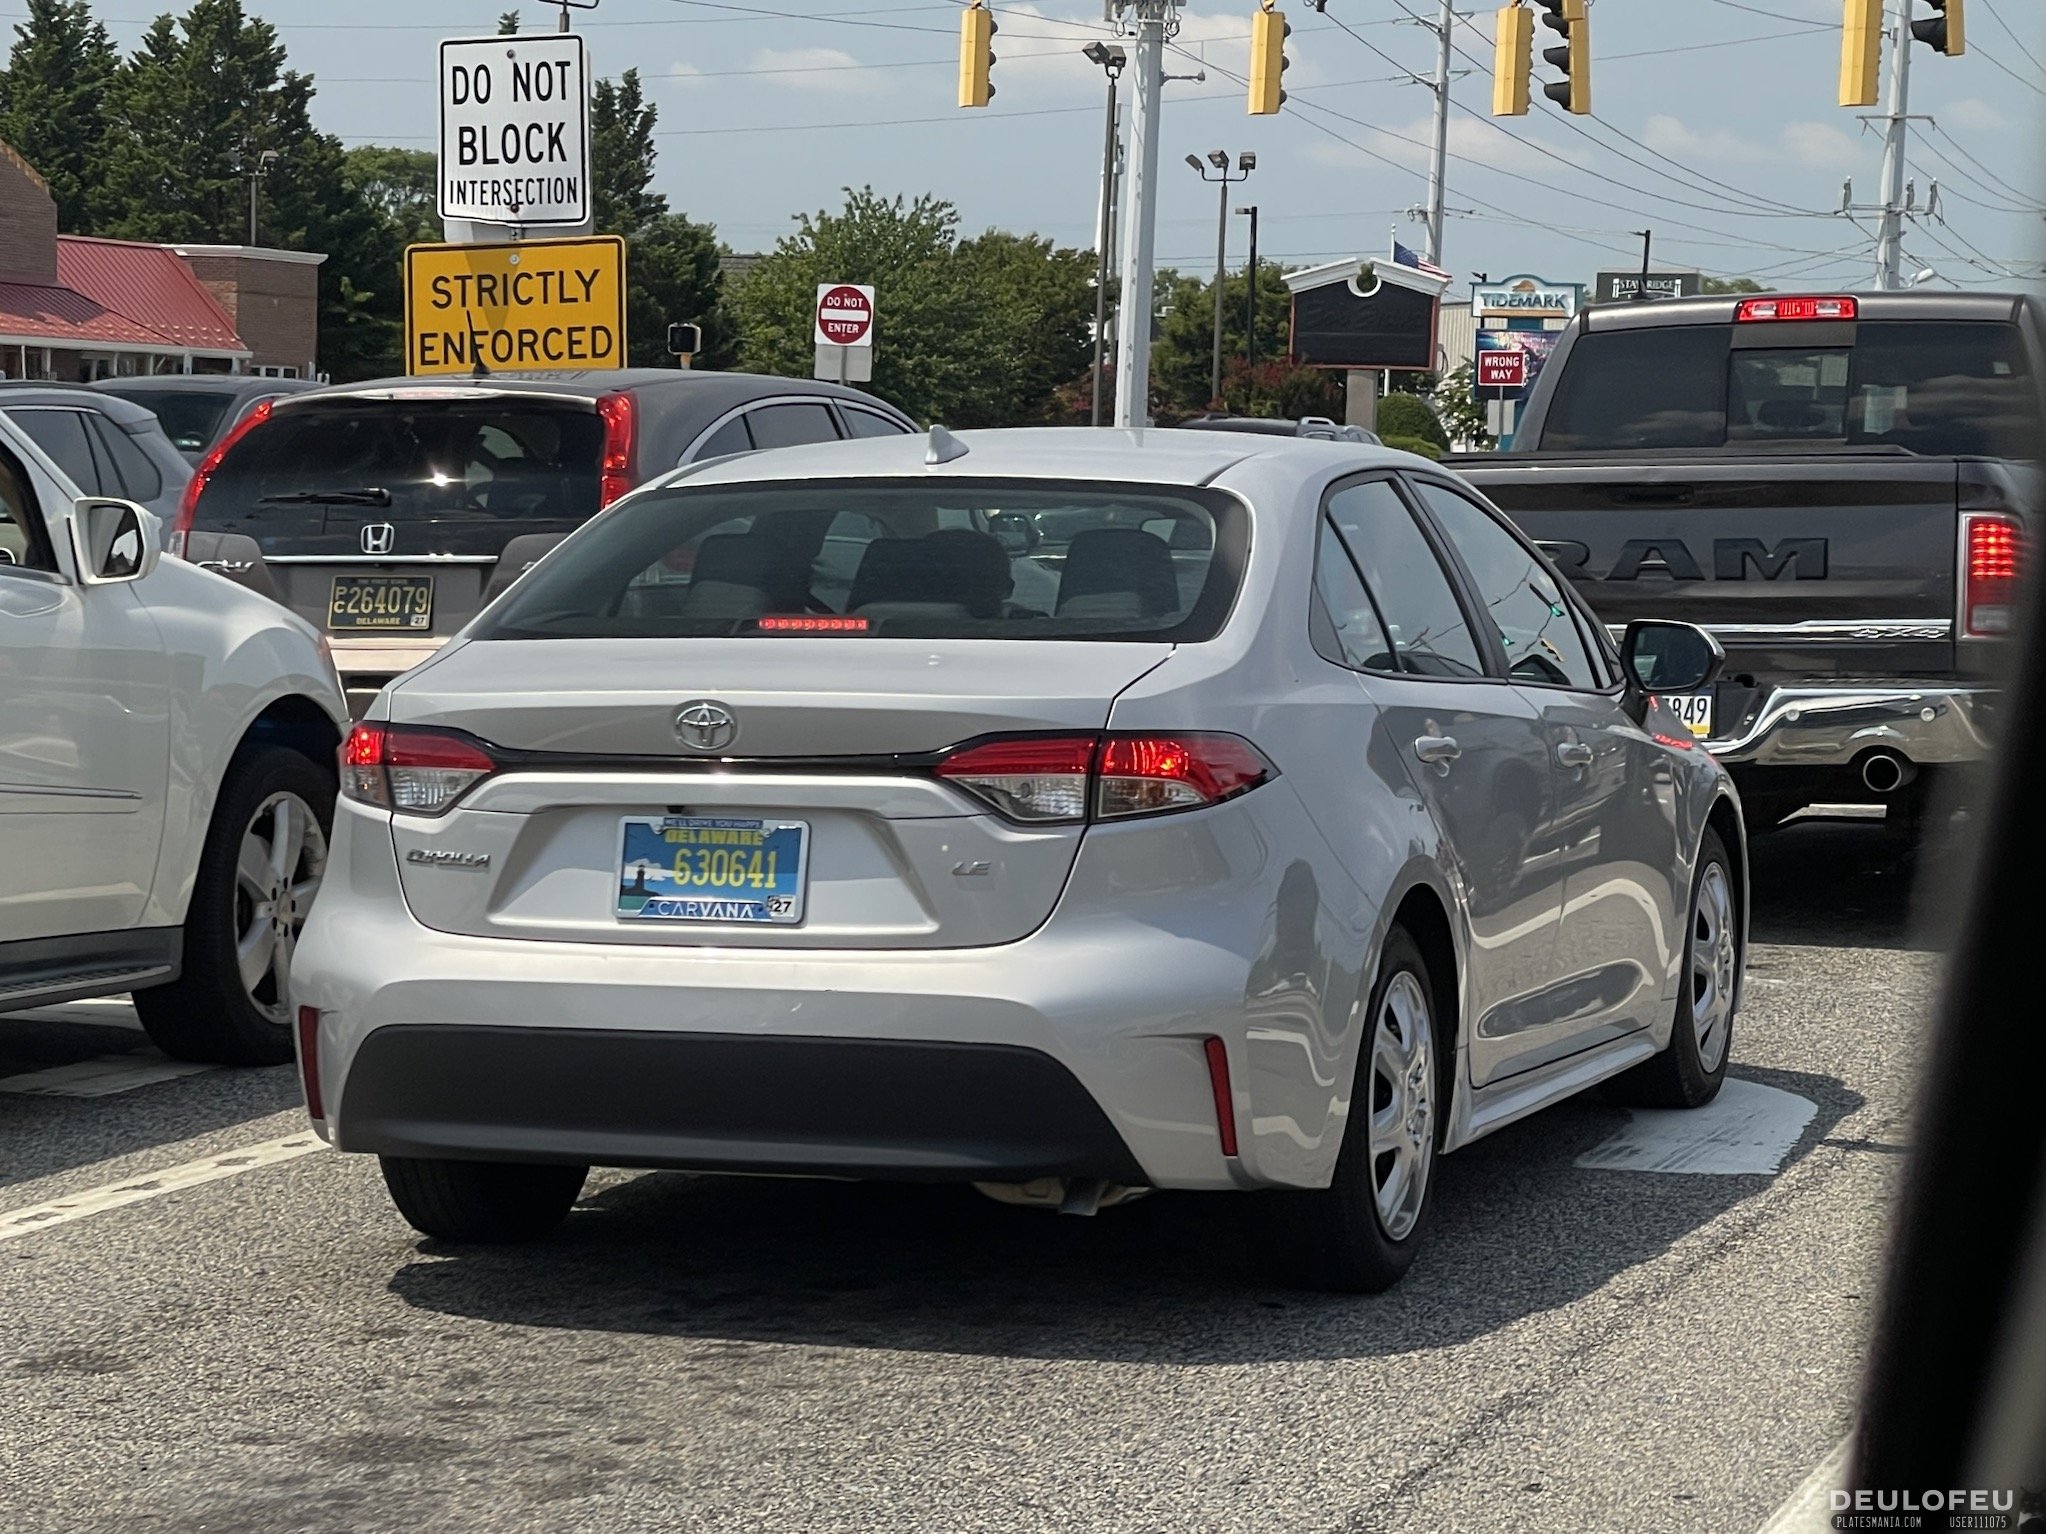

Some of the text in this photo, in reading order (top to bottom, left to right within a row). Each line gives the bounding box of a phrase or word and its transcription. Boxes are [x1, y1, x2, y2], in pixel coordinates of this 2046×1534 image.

[452, 61, 571, 105] DO NOT
[458, 122, 567, 166] BLOCK
[450, 177, 577, 206] INTERSECTION
[431, 269, 600, 309] STRICTLY
[827, 297, 863, 307] DO NOT
[1480, 293, 1567, 308] TIDEMARK
[828, 323, 859, 333] ENTER
[419, 325, 613, 366] ENFORCED
[1484, 356, 1520, 367] WRONG
[1490, 369, 1513, 380] WAY
[346, 586, 429, 614] 264079
[356, 617, 401, 625] DELAWARE
[1666, 697, 1708, 725] 849
[664, 829, 764, 846] DELAWARE
[674, 848, 777, 888] 630641
[952, 860, 992, 876] LE
[658, 901, 754, 918] CARVANA
[772, 900, 792, 913] 27
